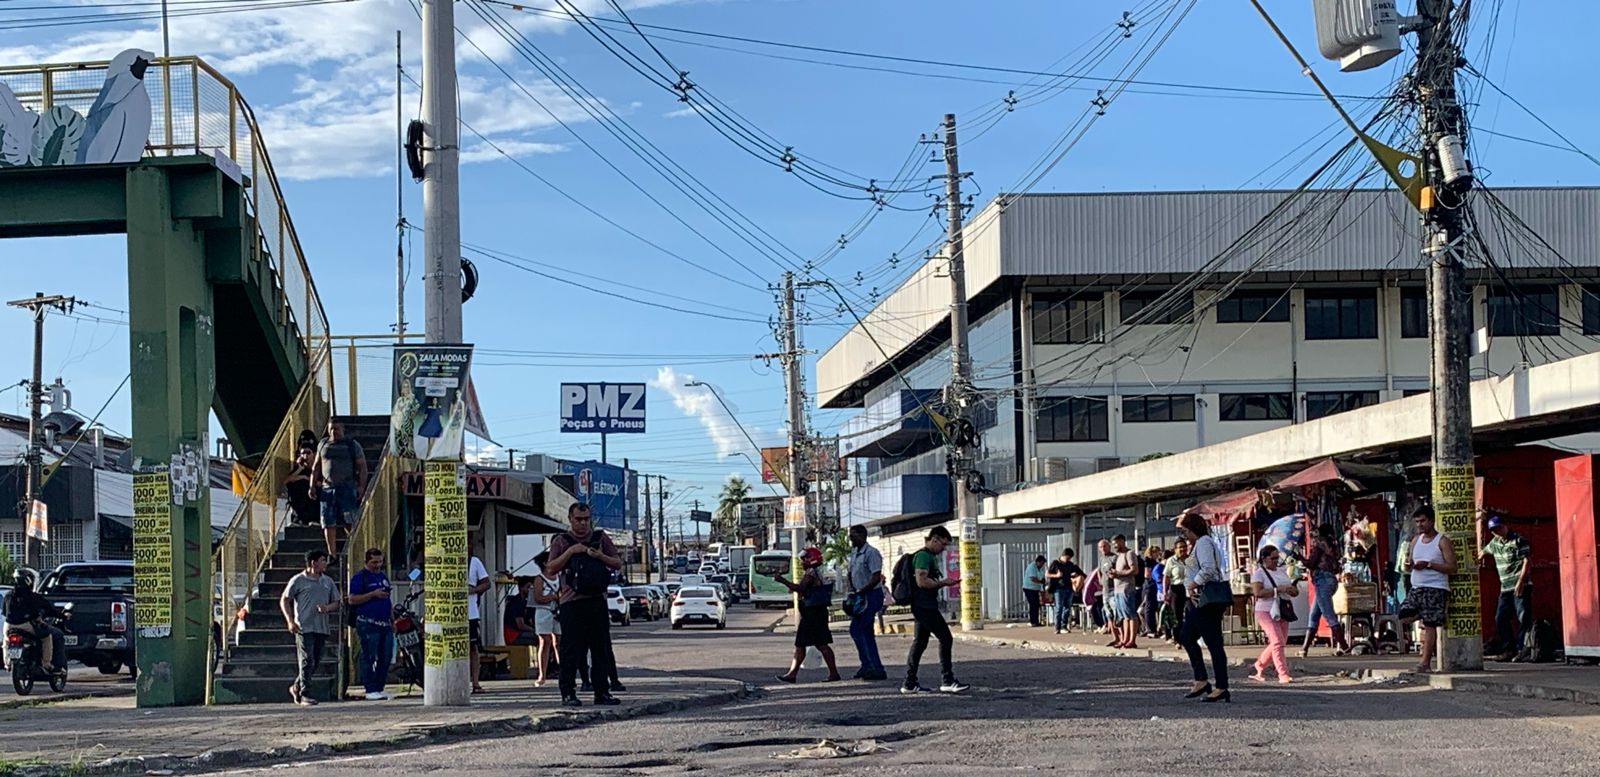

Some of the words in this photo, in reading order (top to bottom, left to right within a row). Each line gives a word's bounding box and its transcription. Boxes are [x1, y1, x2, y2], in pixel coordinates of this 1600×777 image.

[561, 385, 644, 418] PMZ
[561, 419, 594, 430] Peças
[599, 420, 606, 428] e
[610, 419, 644, 428] Pneus
[594, 480, 620, 496] ELÉTRICA
[1440, 481, 1465, 492] 5000
[440, 502, 464, 512] 5000
[1442, 515, 1467, 526] 5000
[441, 537, 465, 548] 5000
[1452, 620, 1477, 630] 5000
